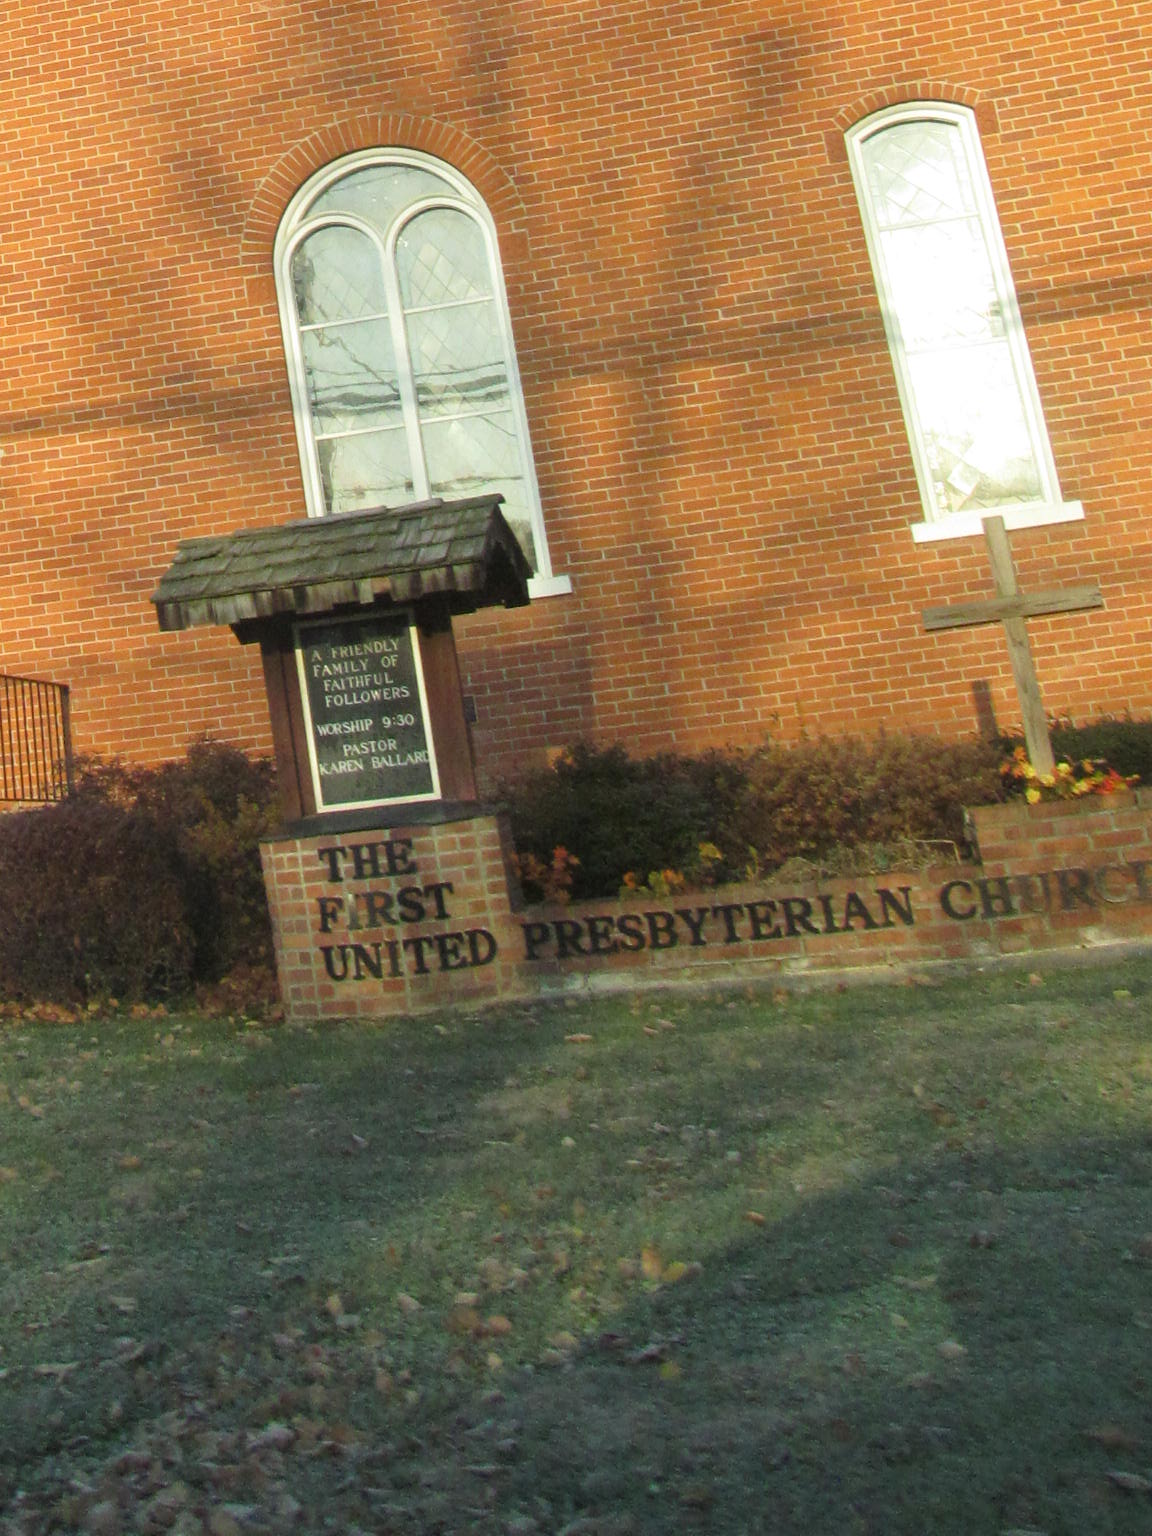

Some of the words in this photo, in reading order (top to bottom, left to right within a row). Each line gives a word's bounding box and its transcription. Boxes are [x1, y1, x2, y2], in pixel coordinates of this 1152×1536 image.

[311, 649, 322, 661] A
[331, 639, 399, 657] FRIENDLY
[313, 659, 368, 677] FAMILY
[381, 655, 398, 667] OF
[323, 672, 393, 691] FAITHFUL
[324, 686, 410, 707] FOLLOWERS
[316, 719, 373, 736] WORSHIP
[381, 714, 414, 728] 9:30
[342, 739, 397, 756] PASTOR
[319, 758, 363, 775] KAREN
[371, 750, 429, 769] BALLARD
[318, 839, 418, 882] THE
[316, 881, 455, 933] FIRST
[319, 928, 497, 982] UNITED
[521, 885, 915, 961] PRESBYTERIAN
